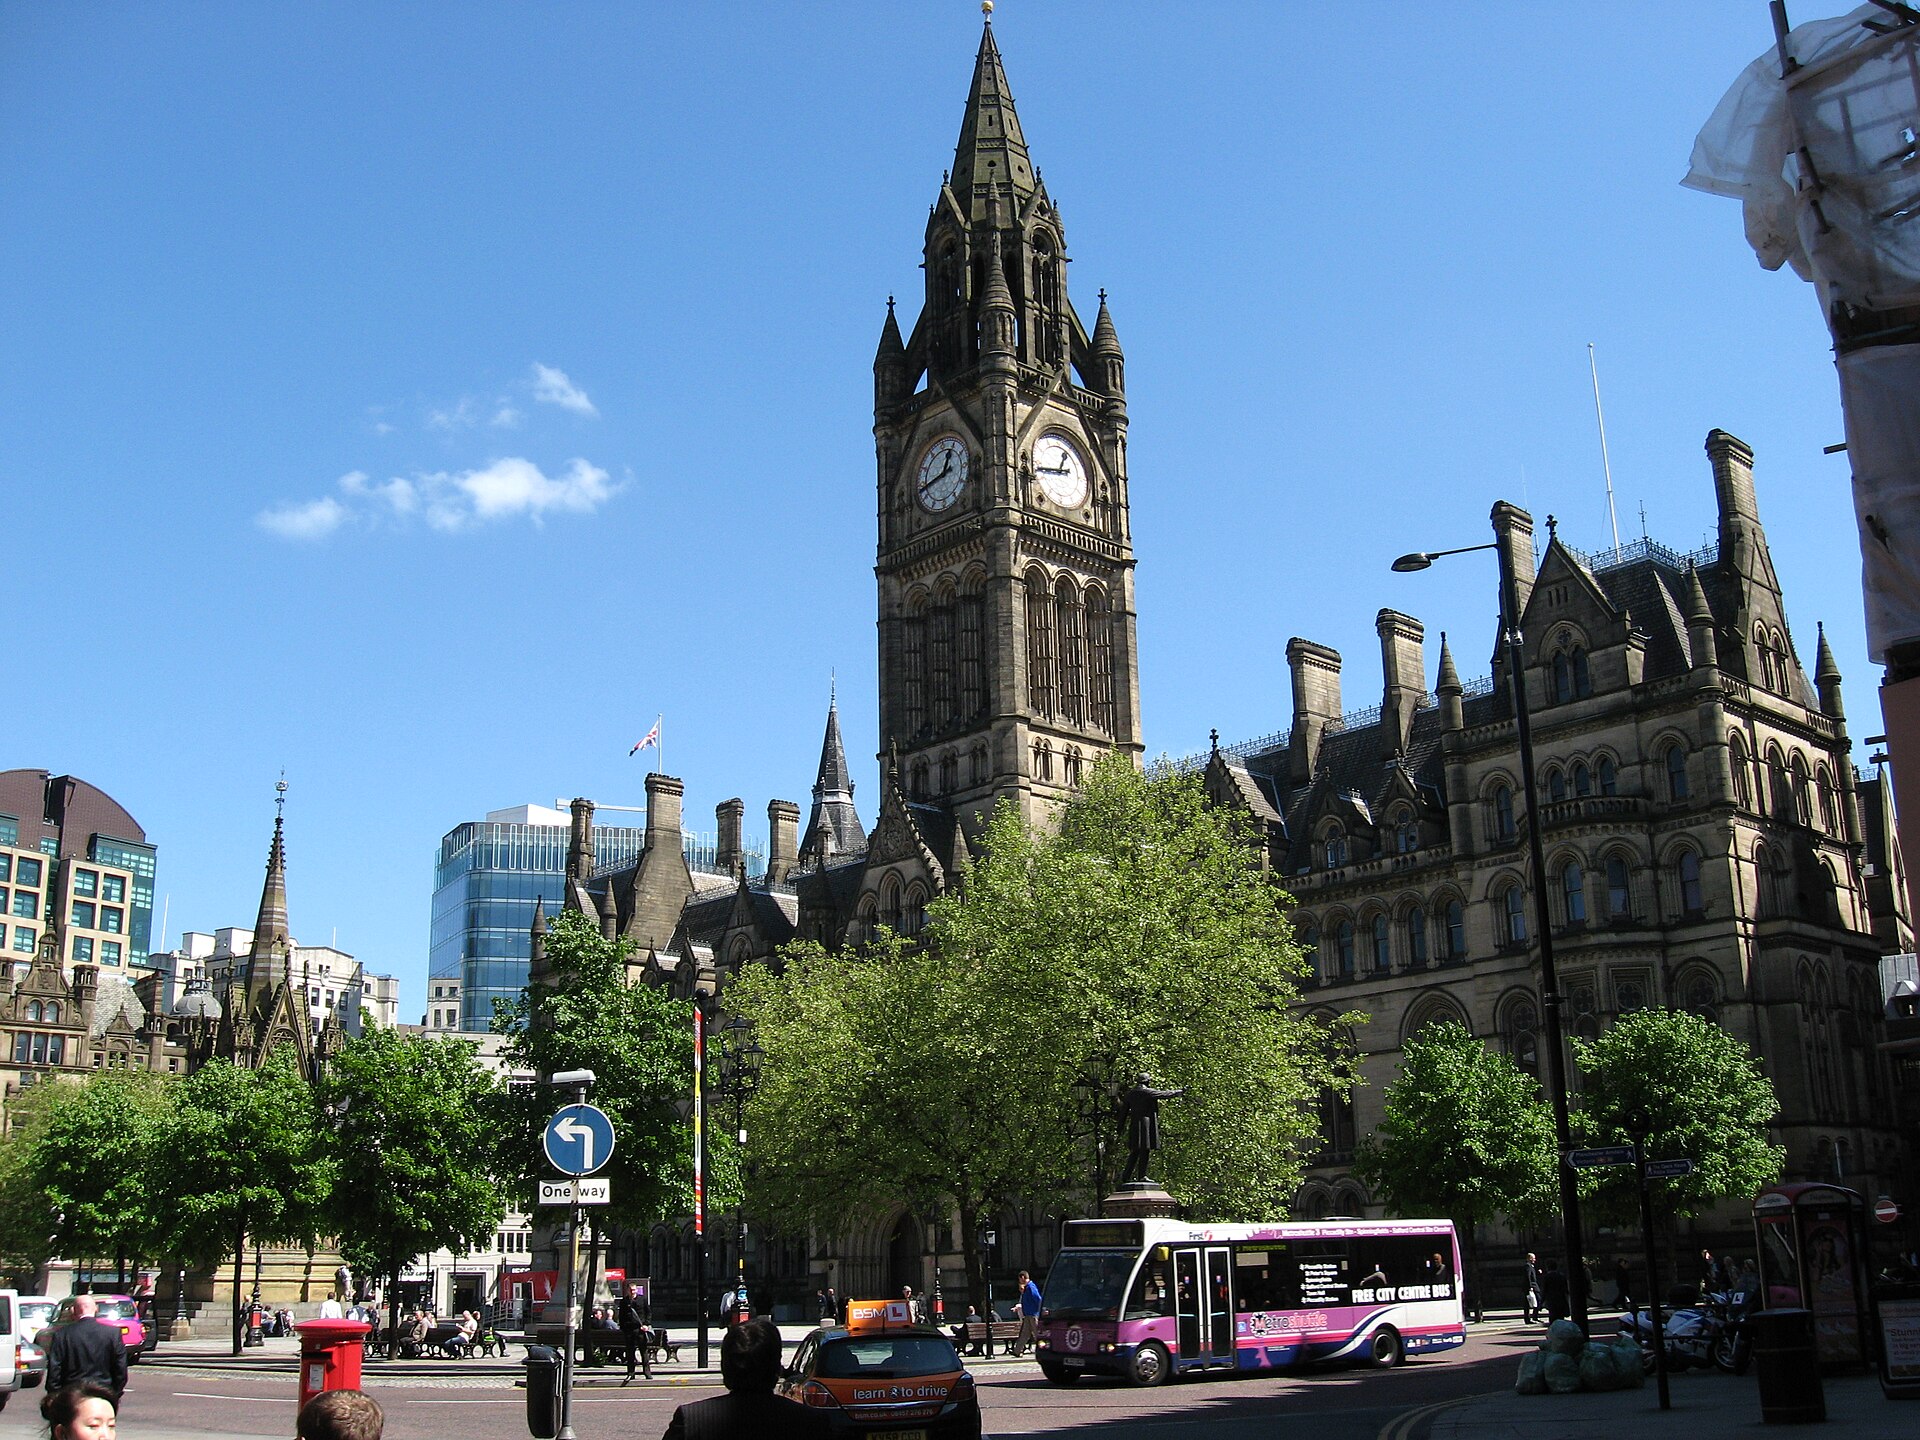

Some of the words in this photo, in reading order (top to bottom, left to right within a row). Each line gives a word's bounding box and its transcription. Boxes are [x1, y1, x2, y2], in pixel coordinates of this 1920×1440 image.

[542, 1186, 571, 1198] One
[579, 1187, 606, 1199] way
[1352, 1289, 1375, 1303] FREE
[1376, 1287, 1396, 1302] CITY
[1398, 1285, 1431, 1300] CENTRE
[1432, 1284, 1451, 1298] BUS
[852, 1308, 886, 1319] BSM
[891, 1306, 903, 1317] L
[1254, 1311, 1328, 1330] Metroshuttle
[853, 1389, 886, 1400] learn
[901, 1387, 914, 1397] to
[917, 1385, 948, 1396] drive
